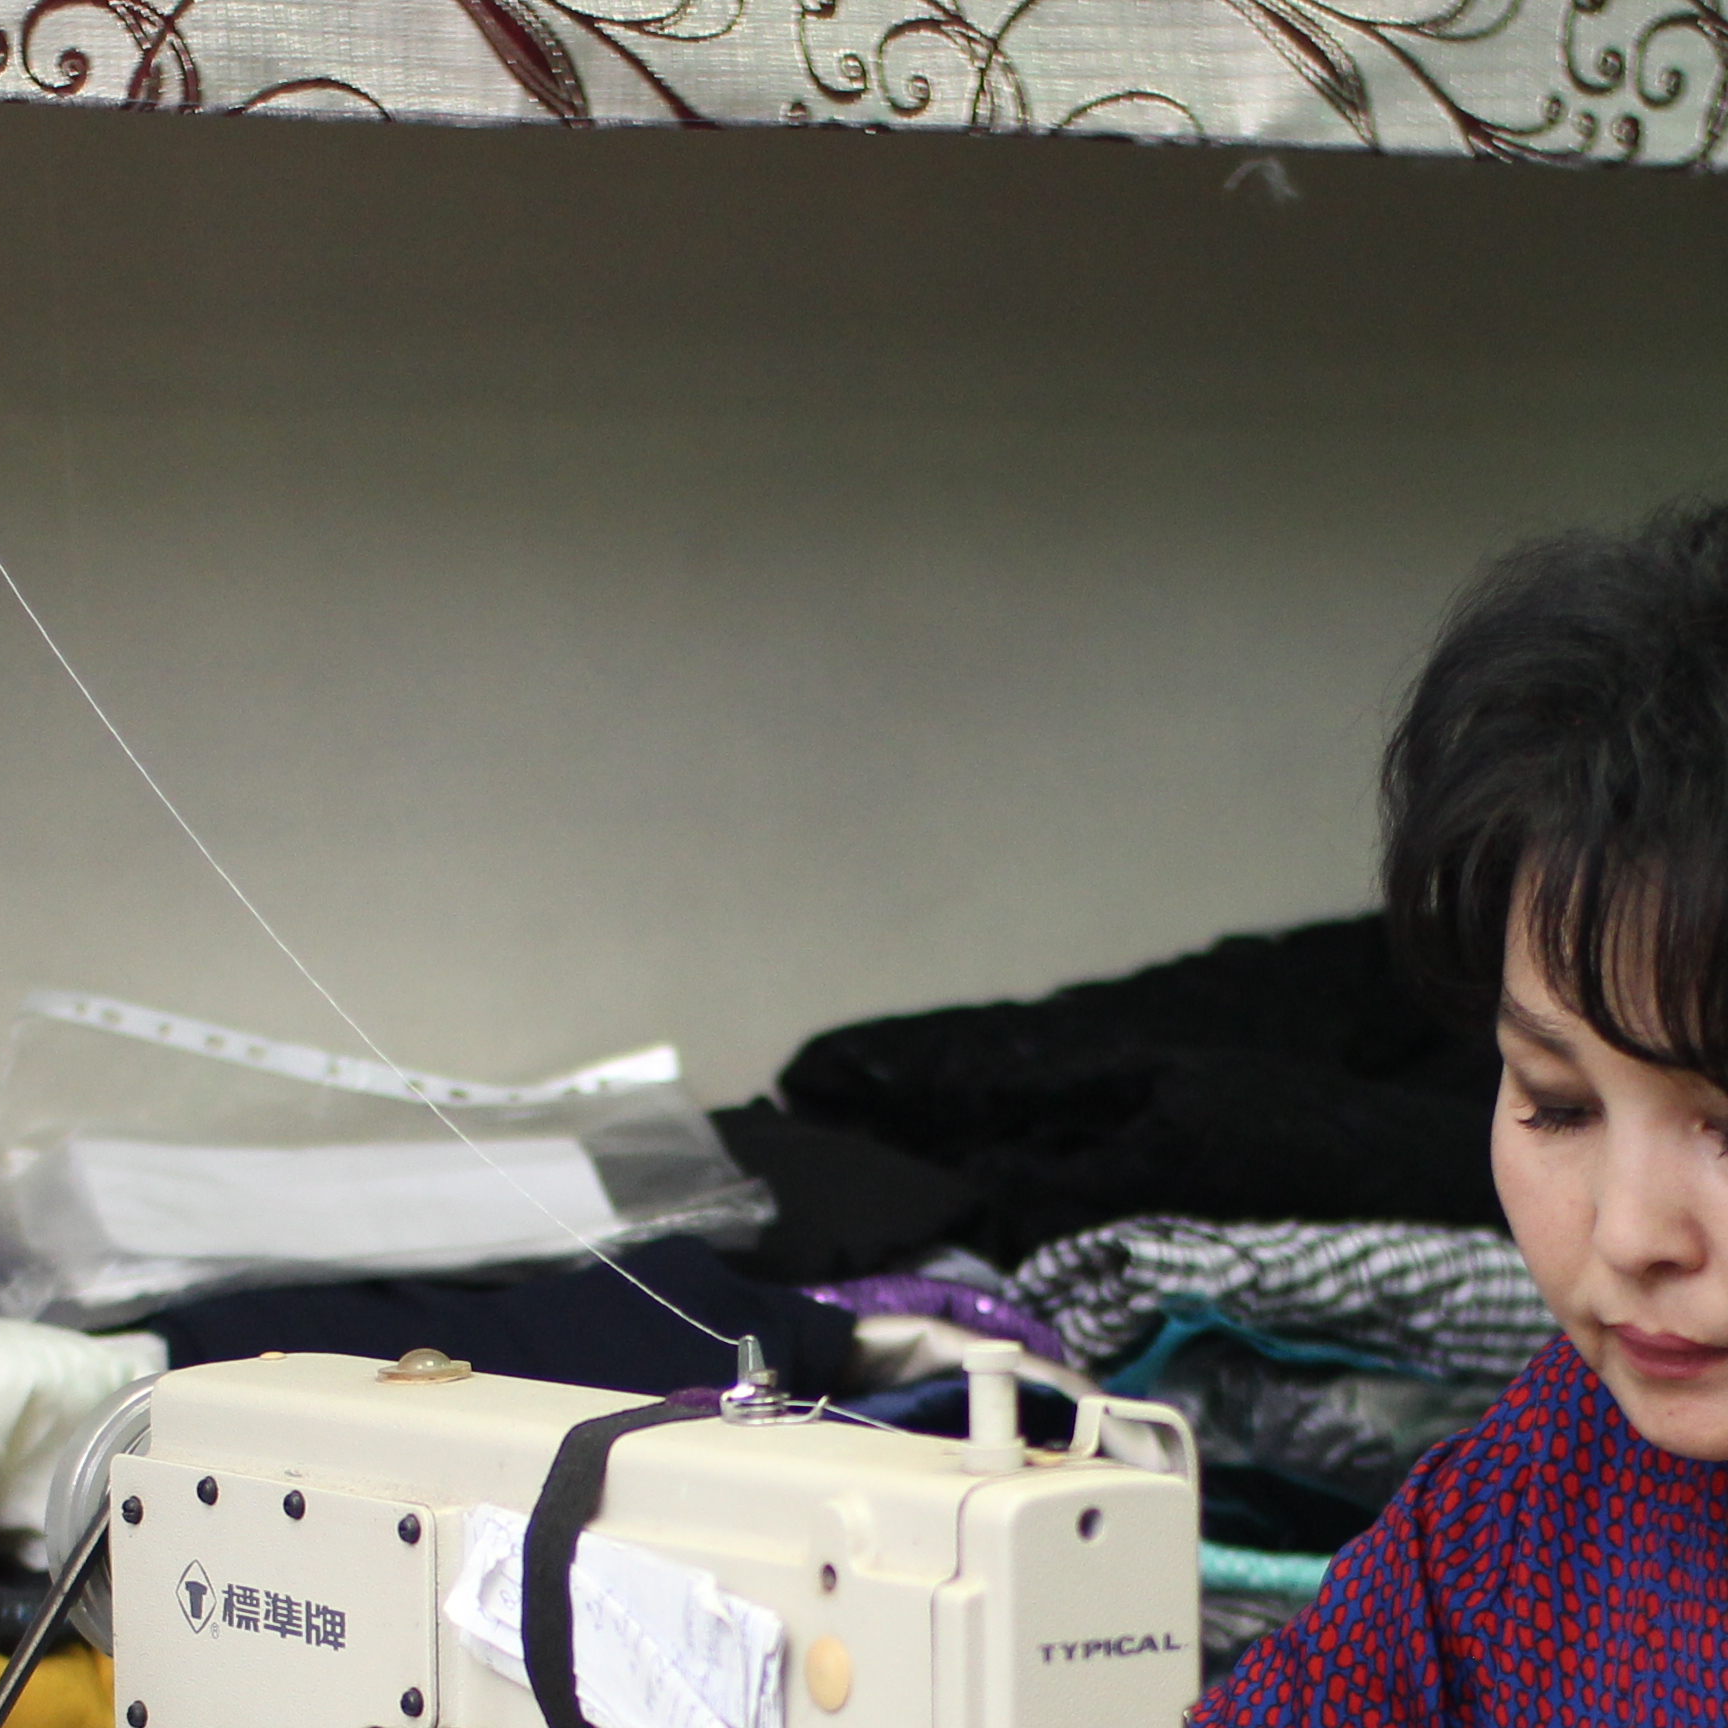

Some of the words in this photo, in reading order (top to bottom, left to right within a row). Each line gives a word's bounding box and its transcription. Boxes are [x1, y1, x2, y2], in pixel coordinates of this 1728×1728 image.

[221, 1583, 347, 1651] 標準牌
[1039, 1633, 1182, 1664] TYPICAL
